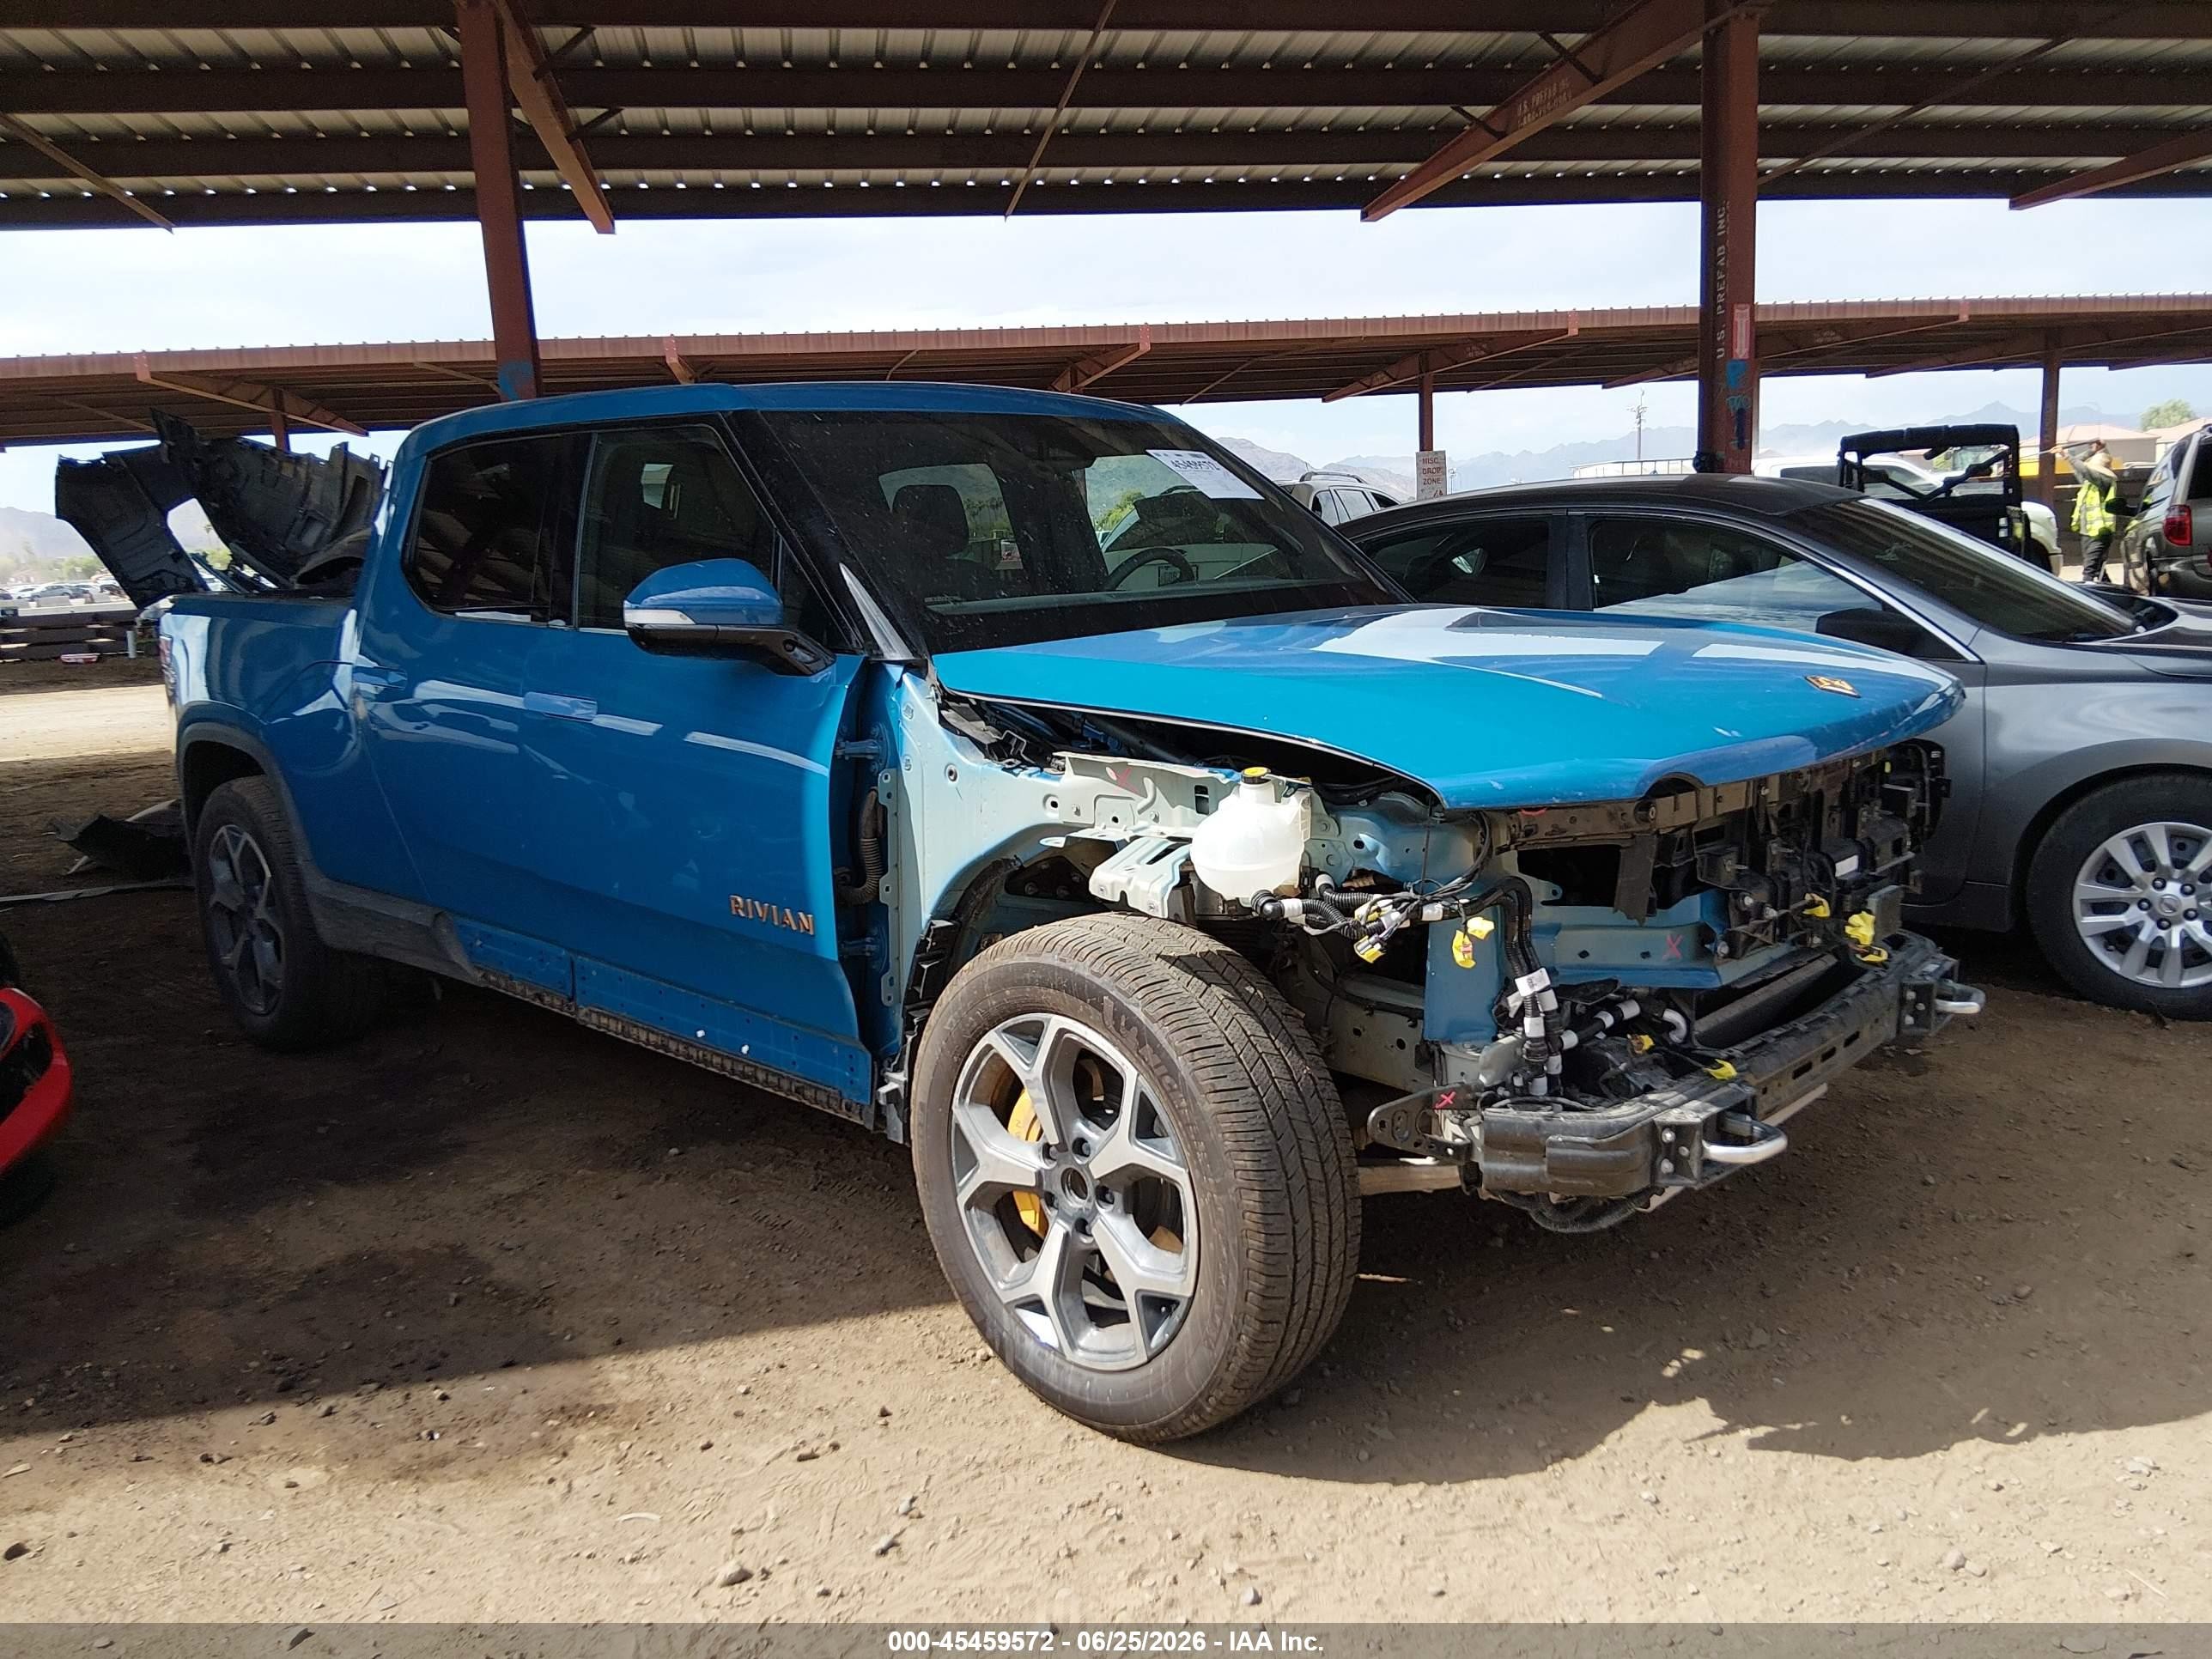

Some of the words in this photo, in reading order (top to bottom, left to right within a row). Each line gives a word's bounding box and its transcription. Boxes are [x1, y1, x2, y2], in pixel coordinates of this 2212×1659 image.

[1717, 200, 1725, 236] INC.
[1717, 246, 1725, 315] PREFAB
[1717, 324, 1725, 359] U.S.
[729, 895, 815, 936] RIVIAN
